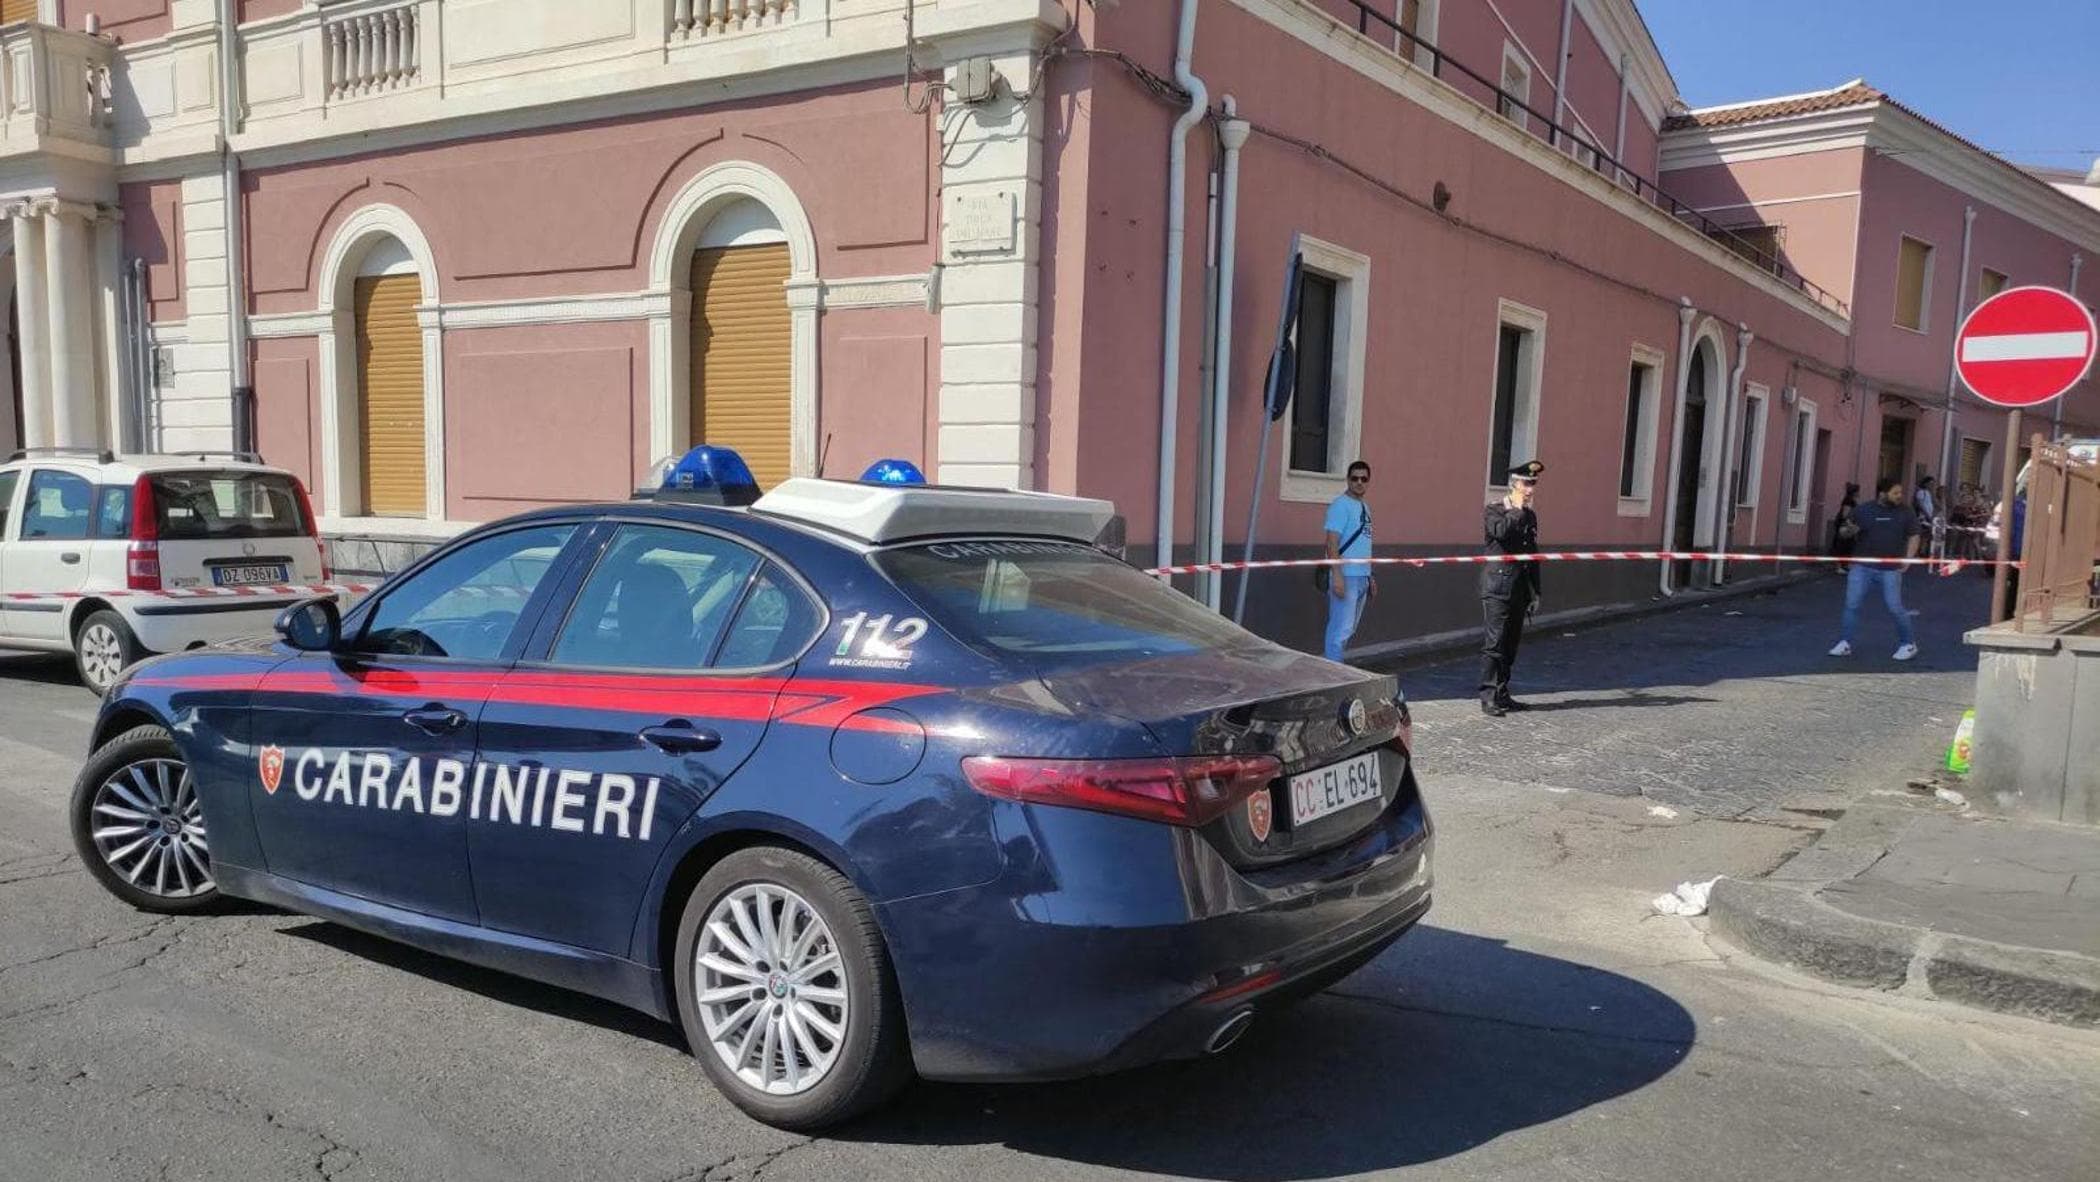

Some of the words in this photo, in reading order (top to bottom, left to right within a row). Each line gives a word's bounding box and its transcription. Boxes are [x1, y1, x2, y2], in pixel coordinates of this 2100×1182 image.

[835, 611, 929, 660] 112
[295, 748, 660, 840] CARABINIERI
[1295, 778, 1316, 818] CC
[1323, 768, 1345, 808] EL
[1348, 757, 1378, 798] 694
